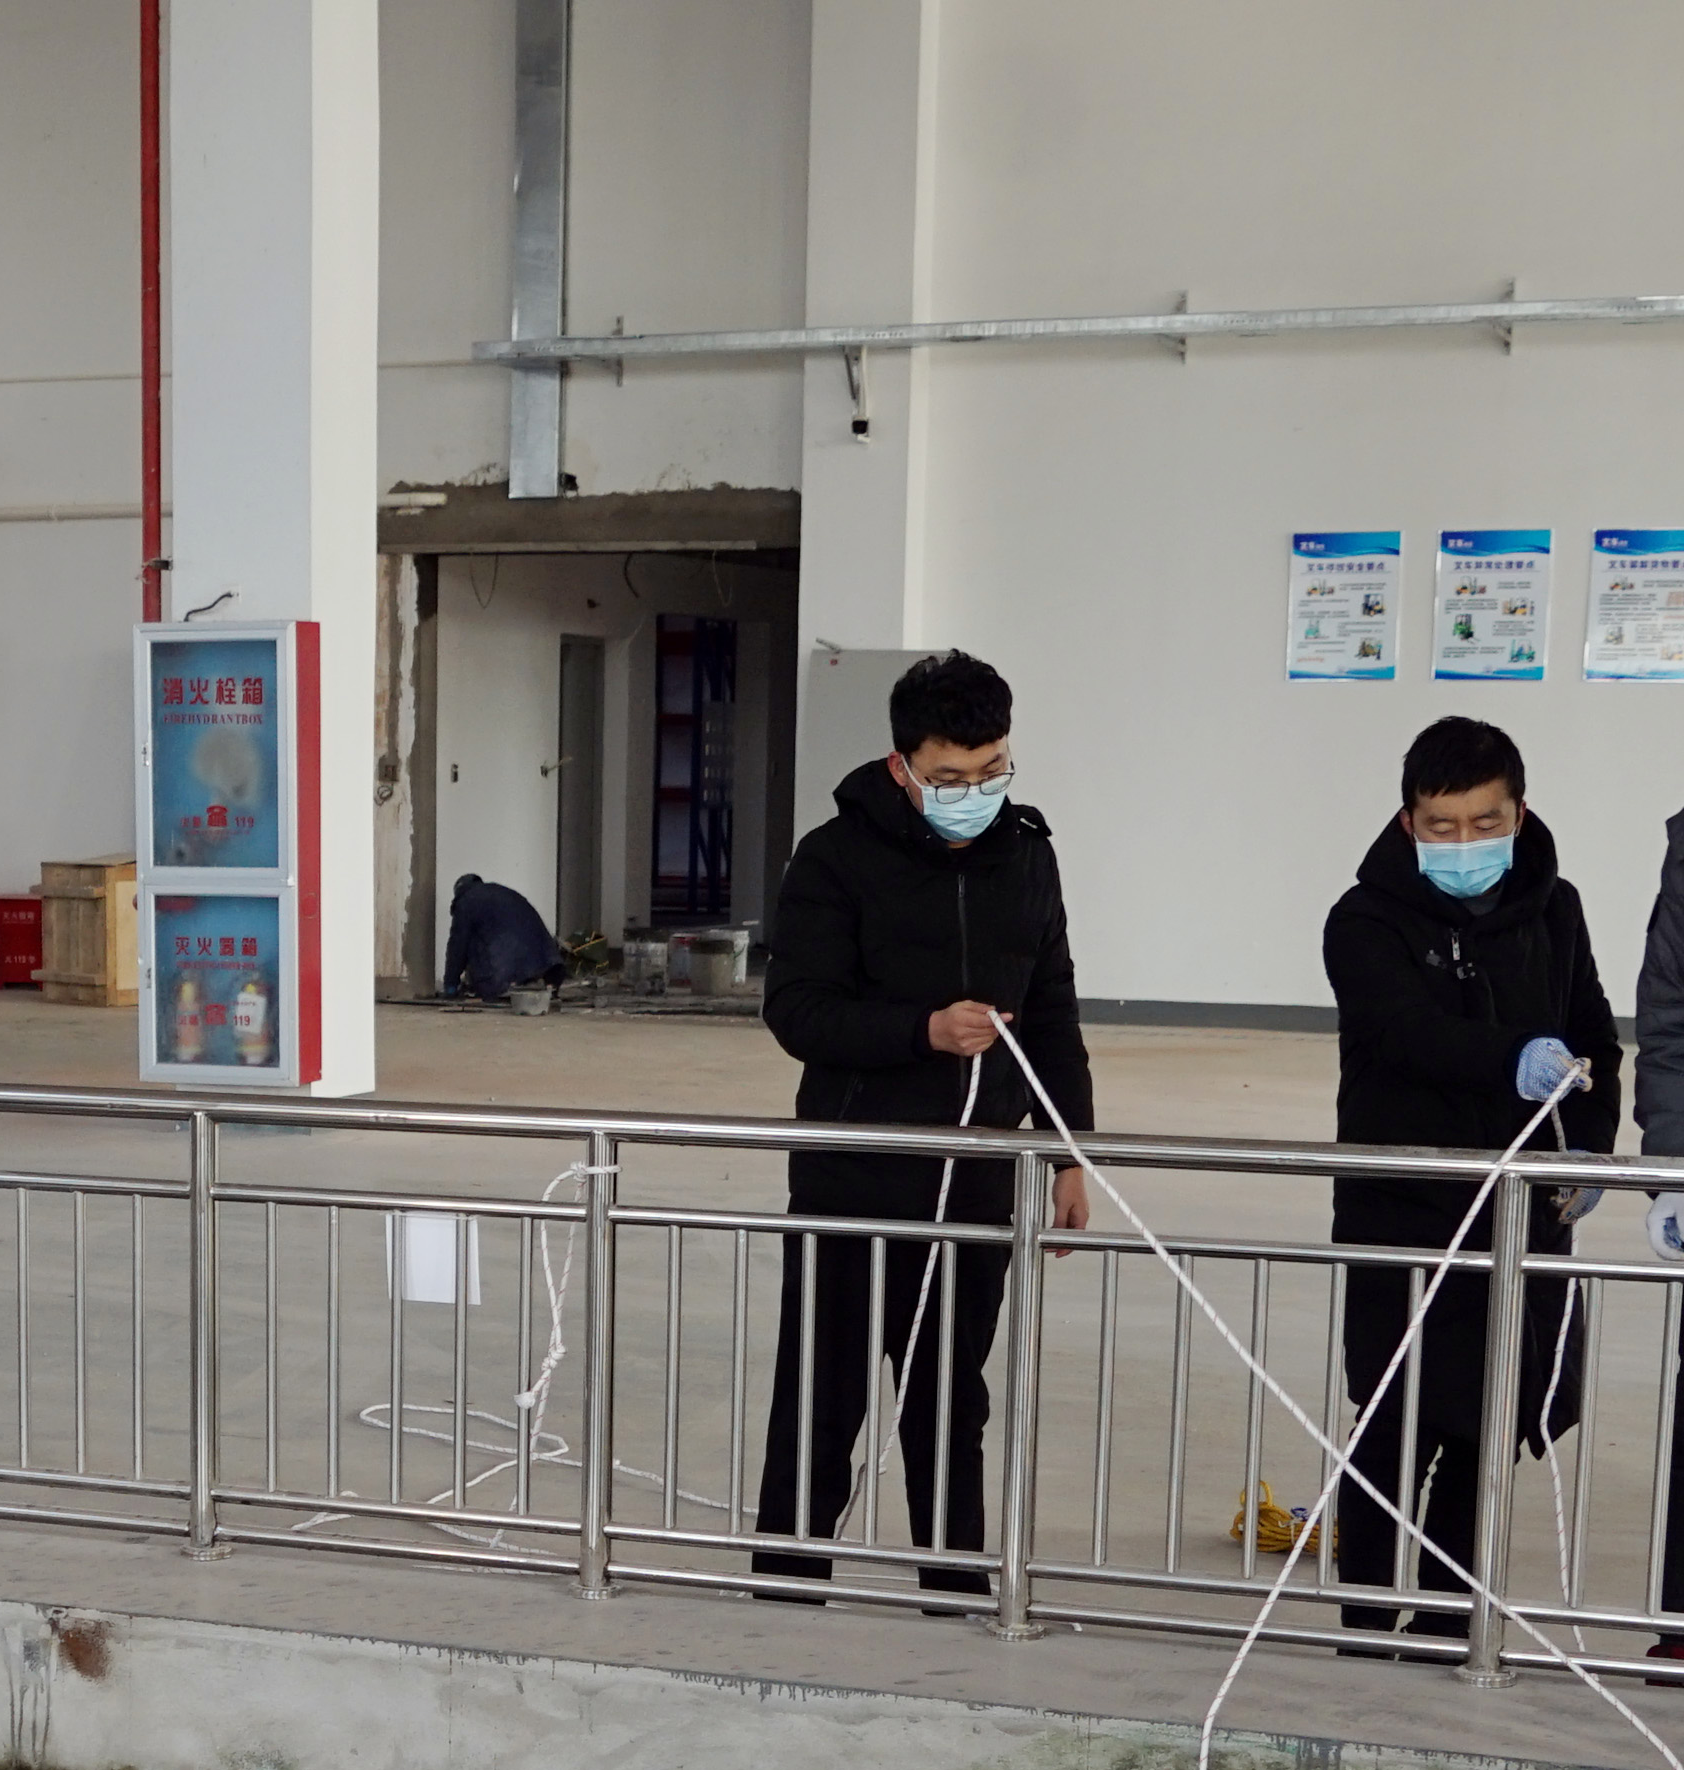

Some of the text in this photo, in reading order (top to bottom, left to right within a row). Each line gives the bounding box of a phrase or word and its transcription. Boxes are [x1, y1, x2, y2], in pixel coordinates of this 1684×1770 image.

[162, 677, 263, 706] 消火栓箱
[175, 937, 257, 957] 灭火器箱
[233, 1015, 251, 1026] 119
